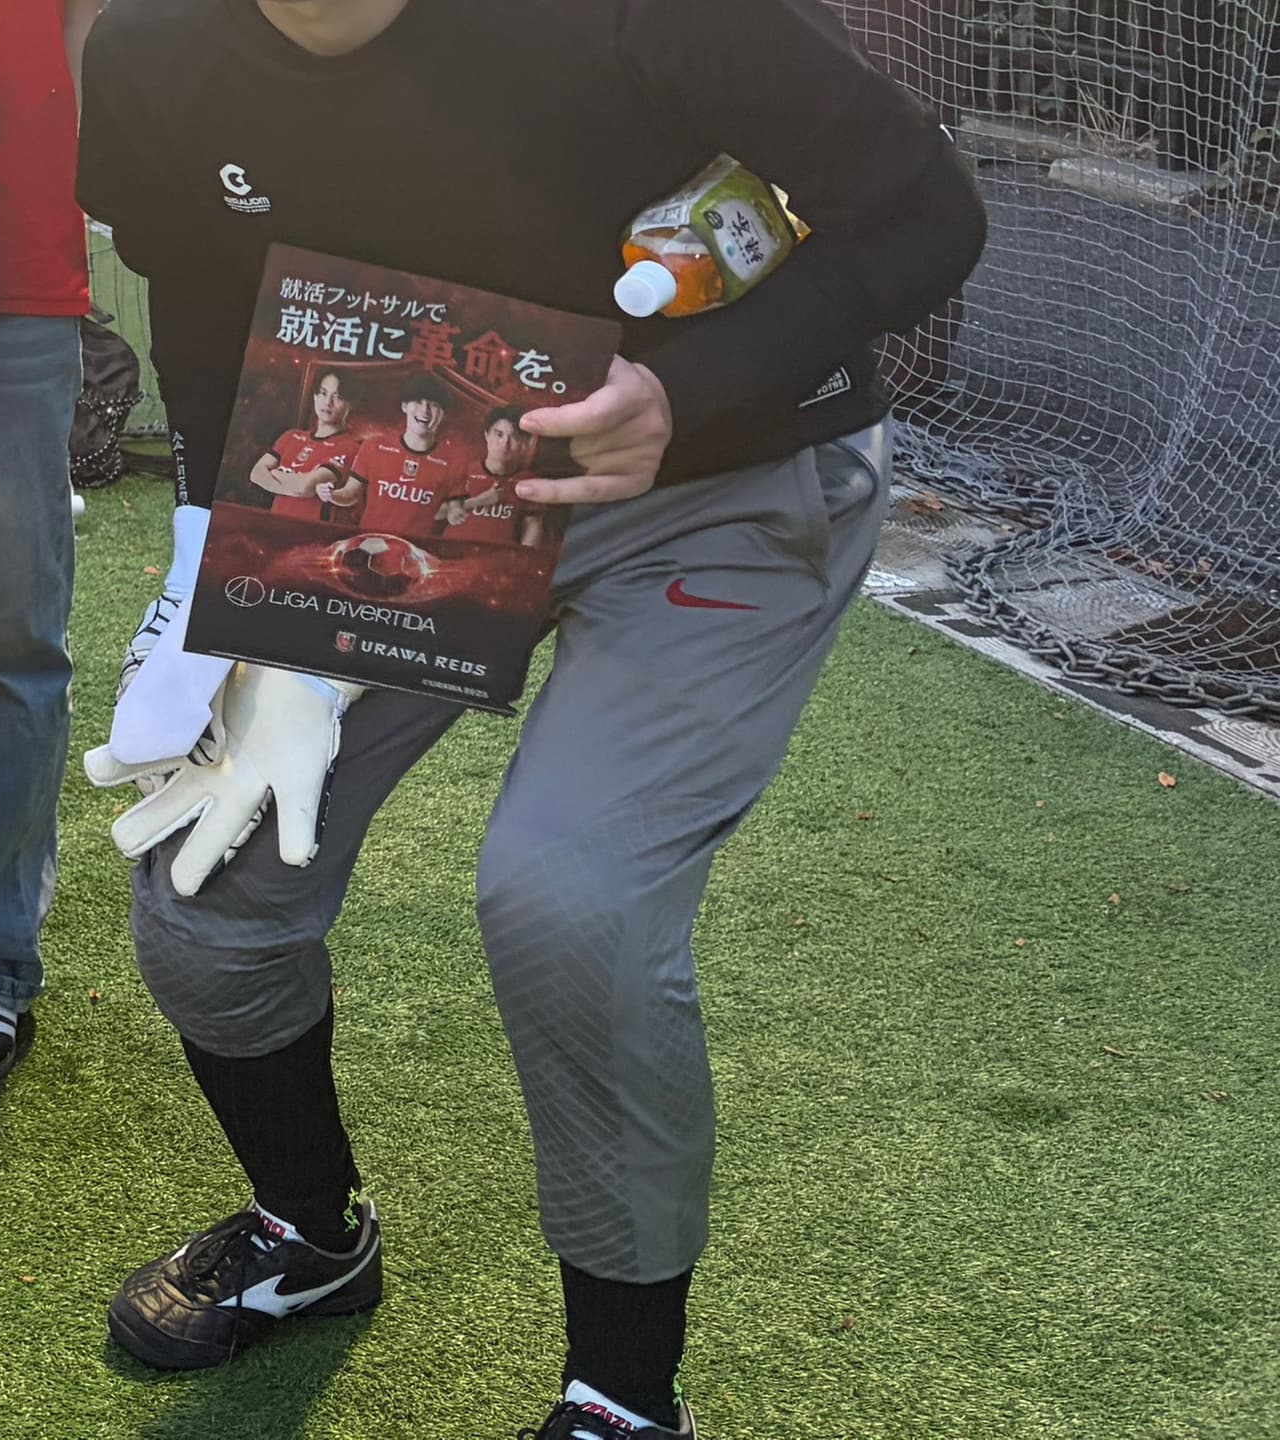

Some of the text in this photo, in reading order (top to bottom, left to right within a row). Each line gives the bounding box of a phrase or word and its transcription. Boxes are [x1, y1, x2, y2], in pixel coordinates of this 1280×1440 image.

[279, 277, 447, 322] 就活フットサルで
[276, 305, 567, 394] 就活に革命を。
[377, 480, 434, 506] POLUS
[361, 641, 487, 678] URAWA REDS
